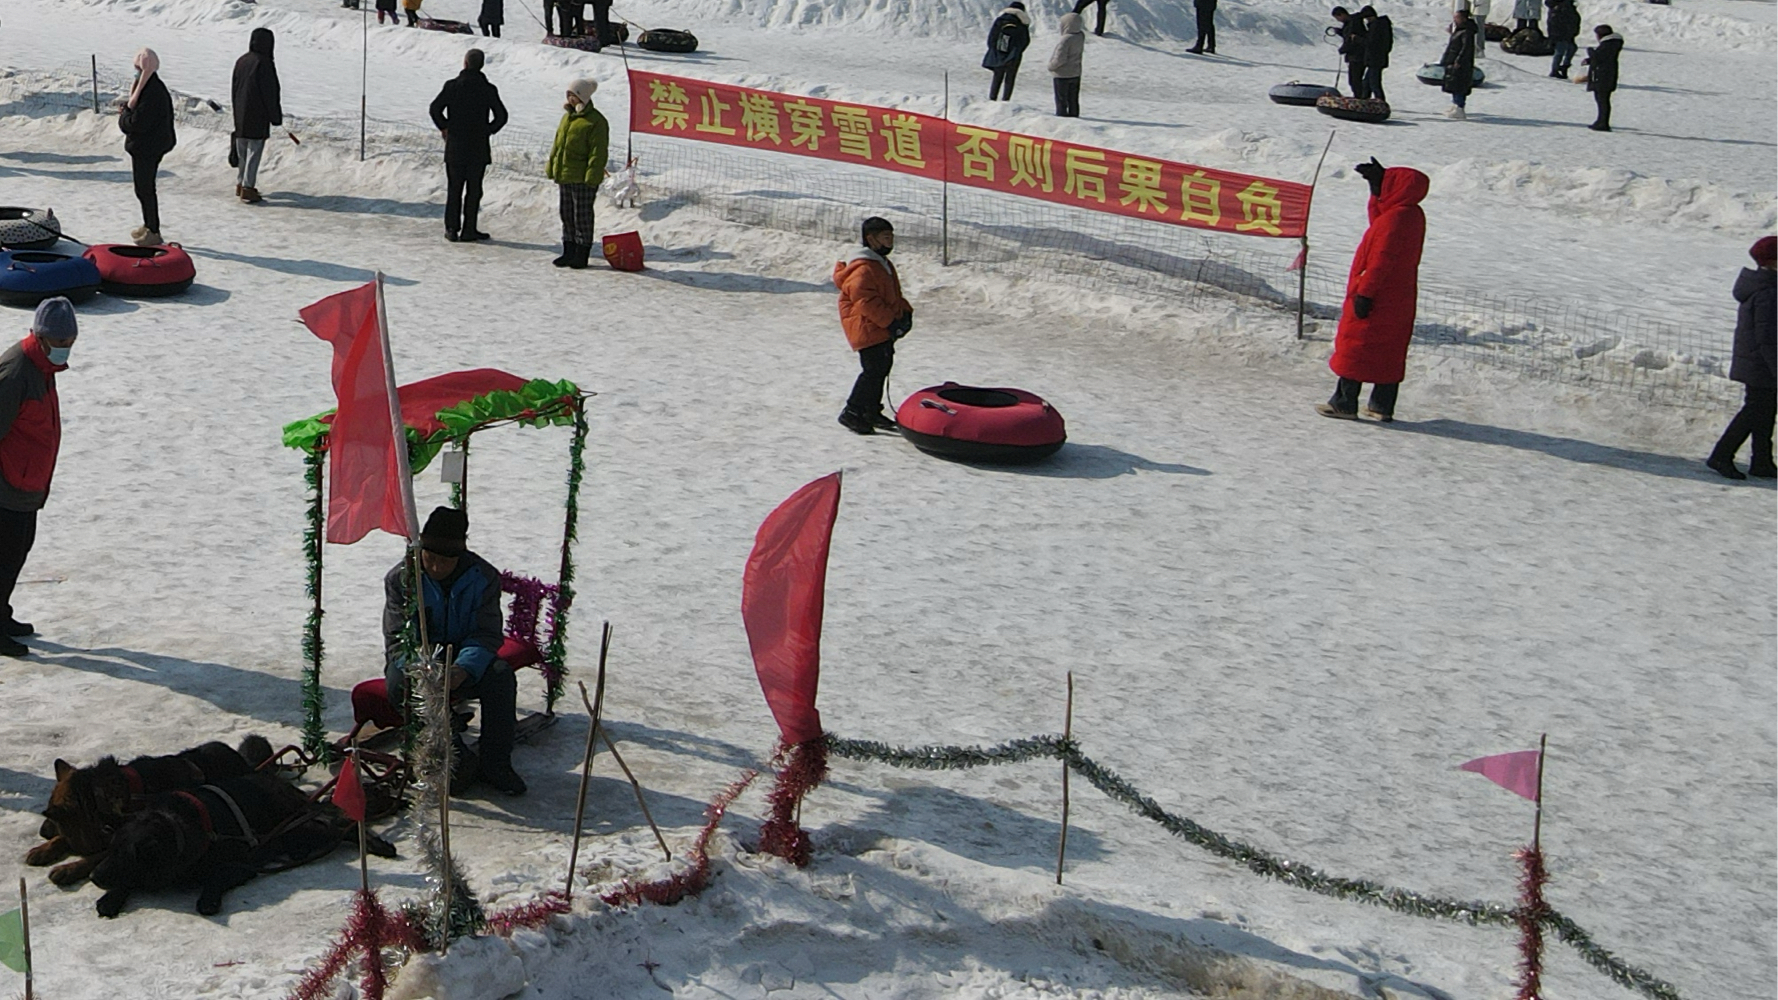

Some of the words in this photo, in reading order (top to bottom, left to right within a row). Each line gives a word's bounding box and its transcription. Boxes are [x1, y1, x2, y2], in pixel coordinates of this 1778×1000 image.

[649, 79, 926, 168] 禁止横穿雪道
[956, 126, 1283, 236] 否则后果自负
